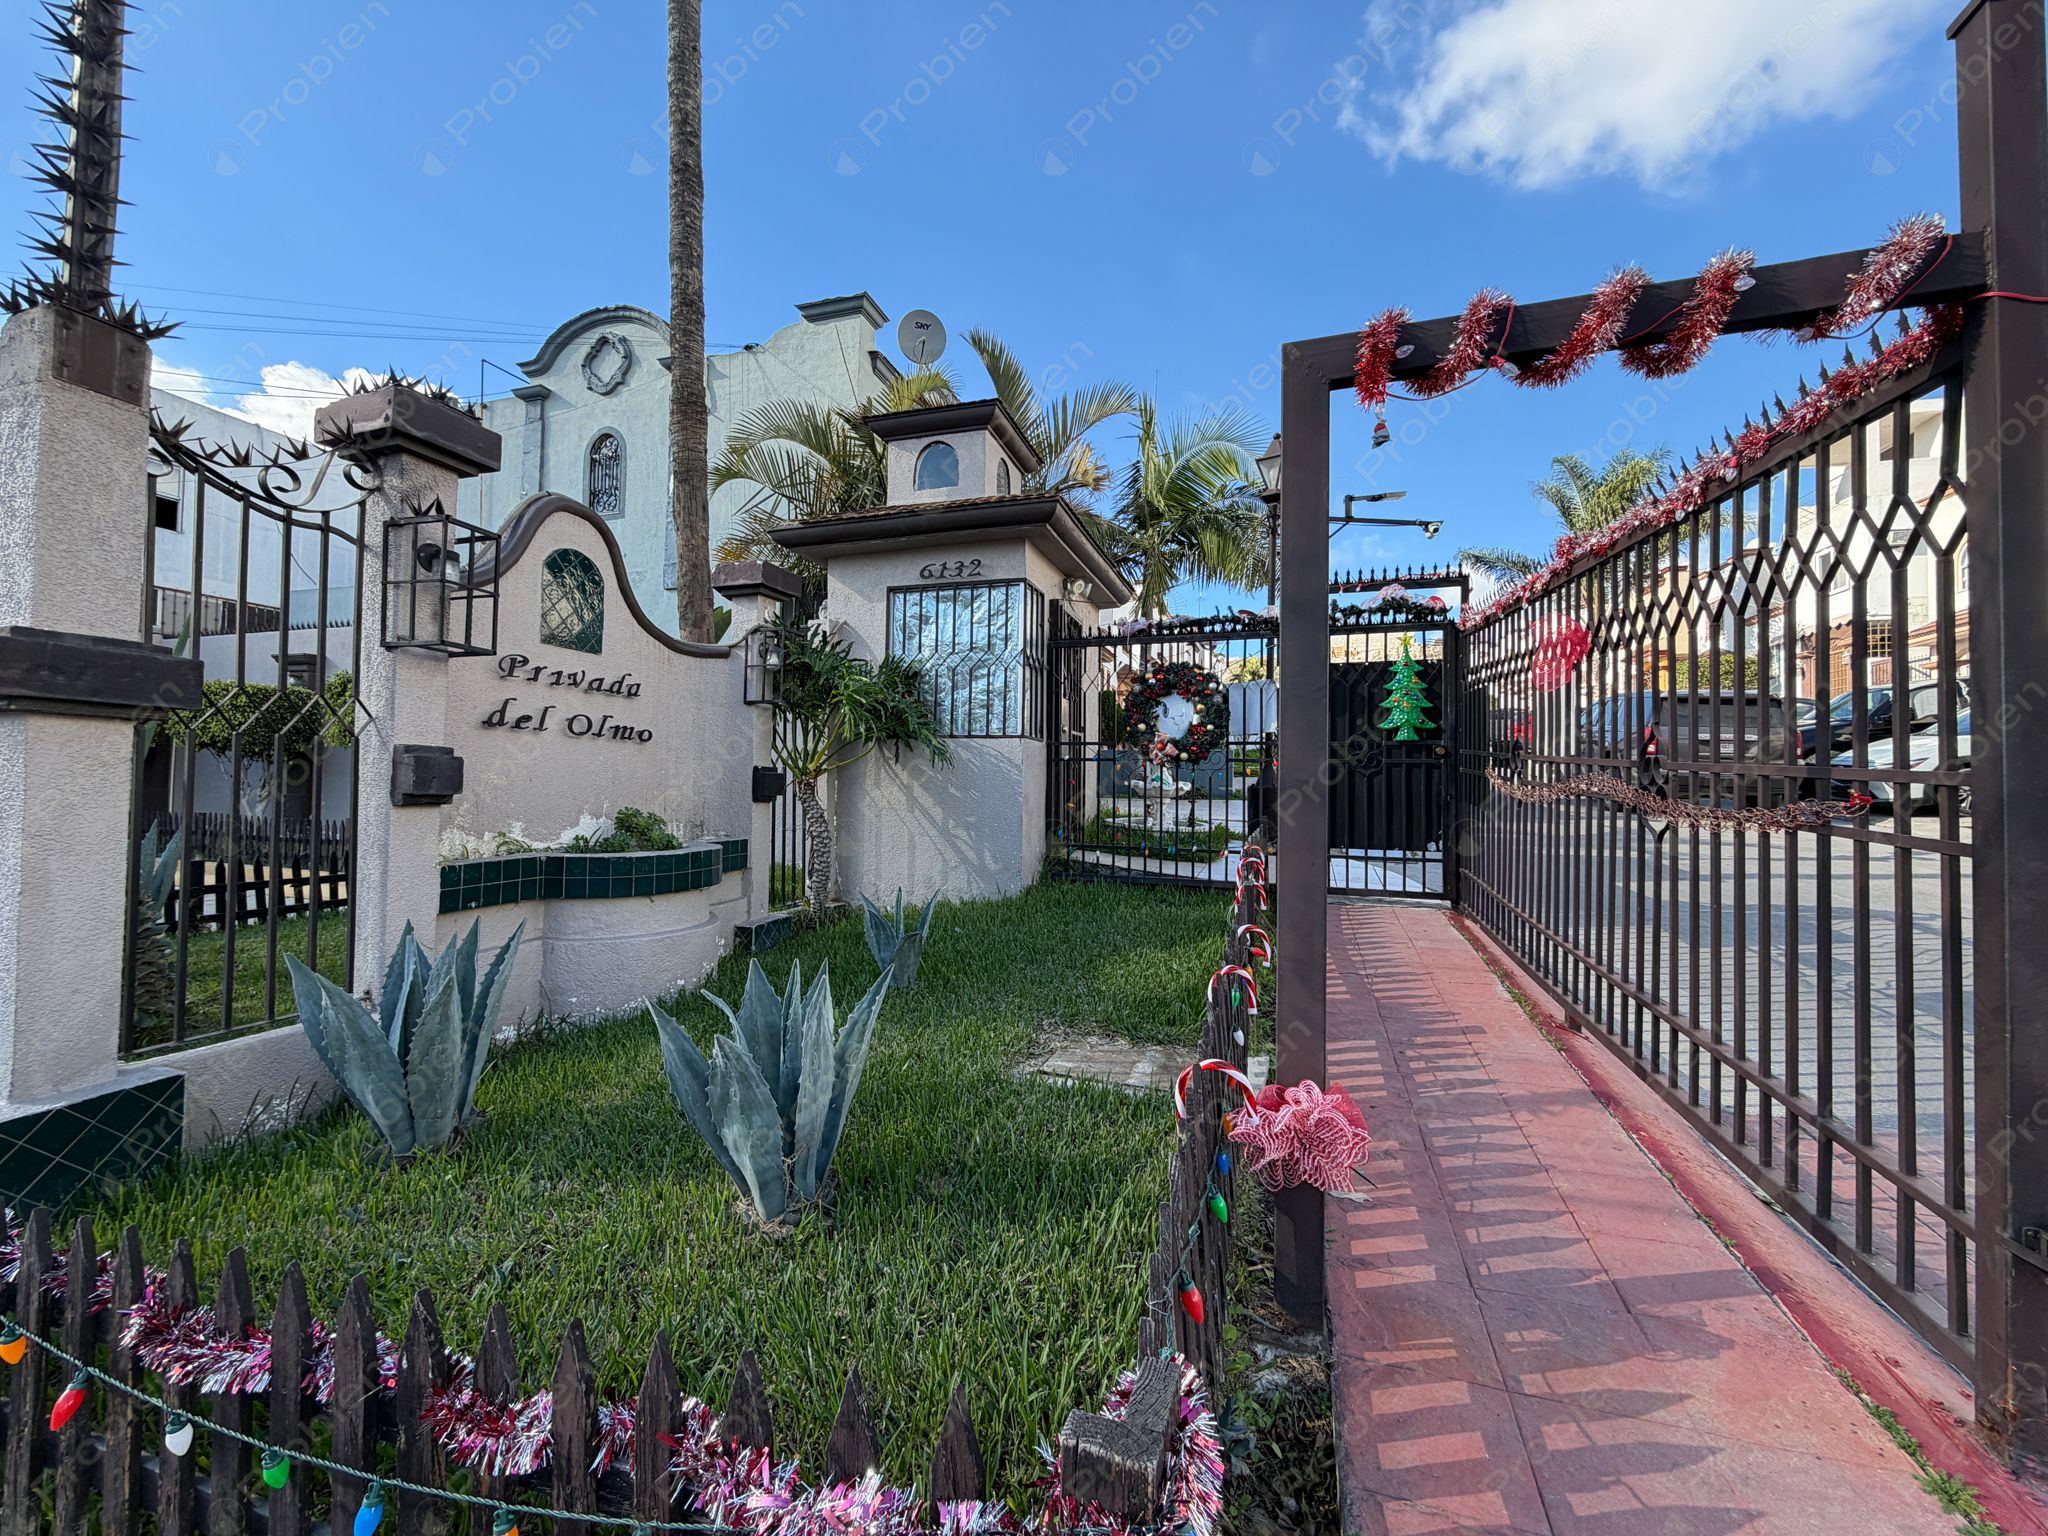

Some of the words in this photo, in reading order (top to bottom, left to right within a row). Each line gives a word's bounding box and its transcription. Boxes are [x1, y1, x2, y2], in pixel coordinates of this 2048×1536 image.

[914, 321, 932, 331] SKY
[919, 558, 982, 579] 6132
[498, 653, 642, 697] Privada
[481, 697, 557, 732] del
[565, 713, 653, 743] Olmo
